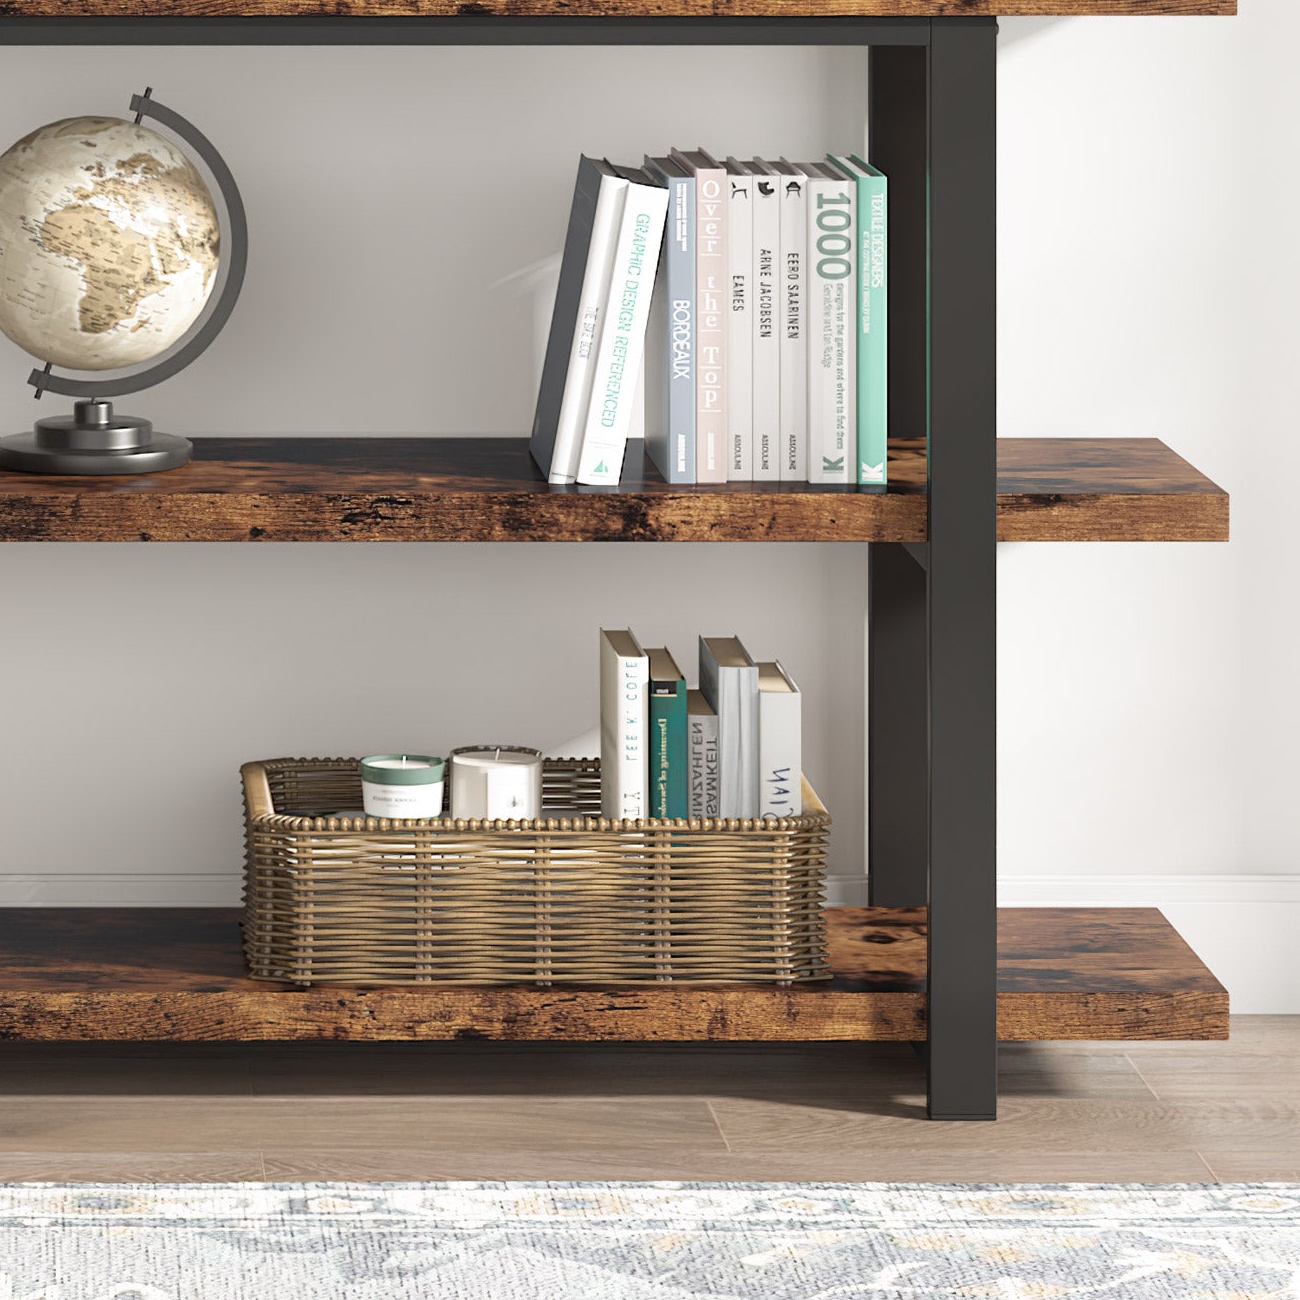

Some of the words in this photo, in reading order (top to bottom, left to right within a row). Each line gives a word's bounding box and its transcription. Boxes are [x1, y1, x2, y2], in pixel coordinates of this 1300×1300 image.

[702, 180, 721, 252] Over
[816, 192, 851, 280] 1000
[627, 213, 651, 276] GRAPHIC
[760, 249, 772, 277] ARNE
[787, 253, 799, 280] EERO
[618, 280, 639, 331] DESIGN
[705, 276, 717, 328] the
[733, 275, 745, 312] EAMES
[760, 282, 772, 338] JACOBSEN
[787, 284, 799, 339] SAARINEN
[672, 300, 691, 380] BORDEAUX
[601, 336, 629, 428] REFERENCED
